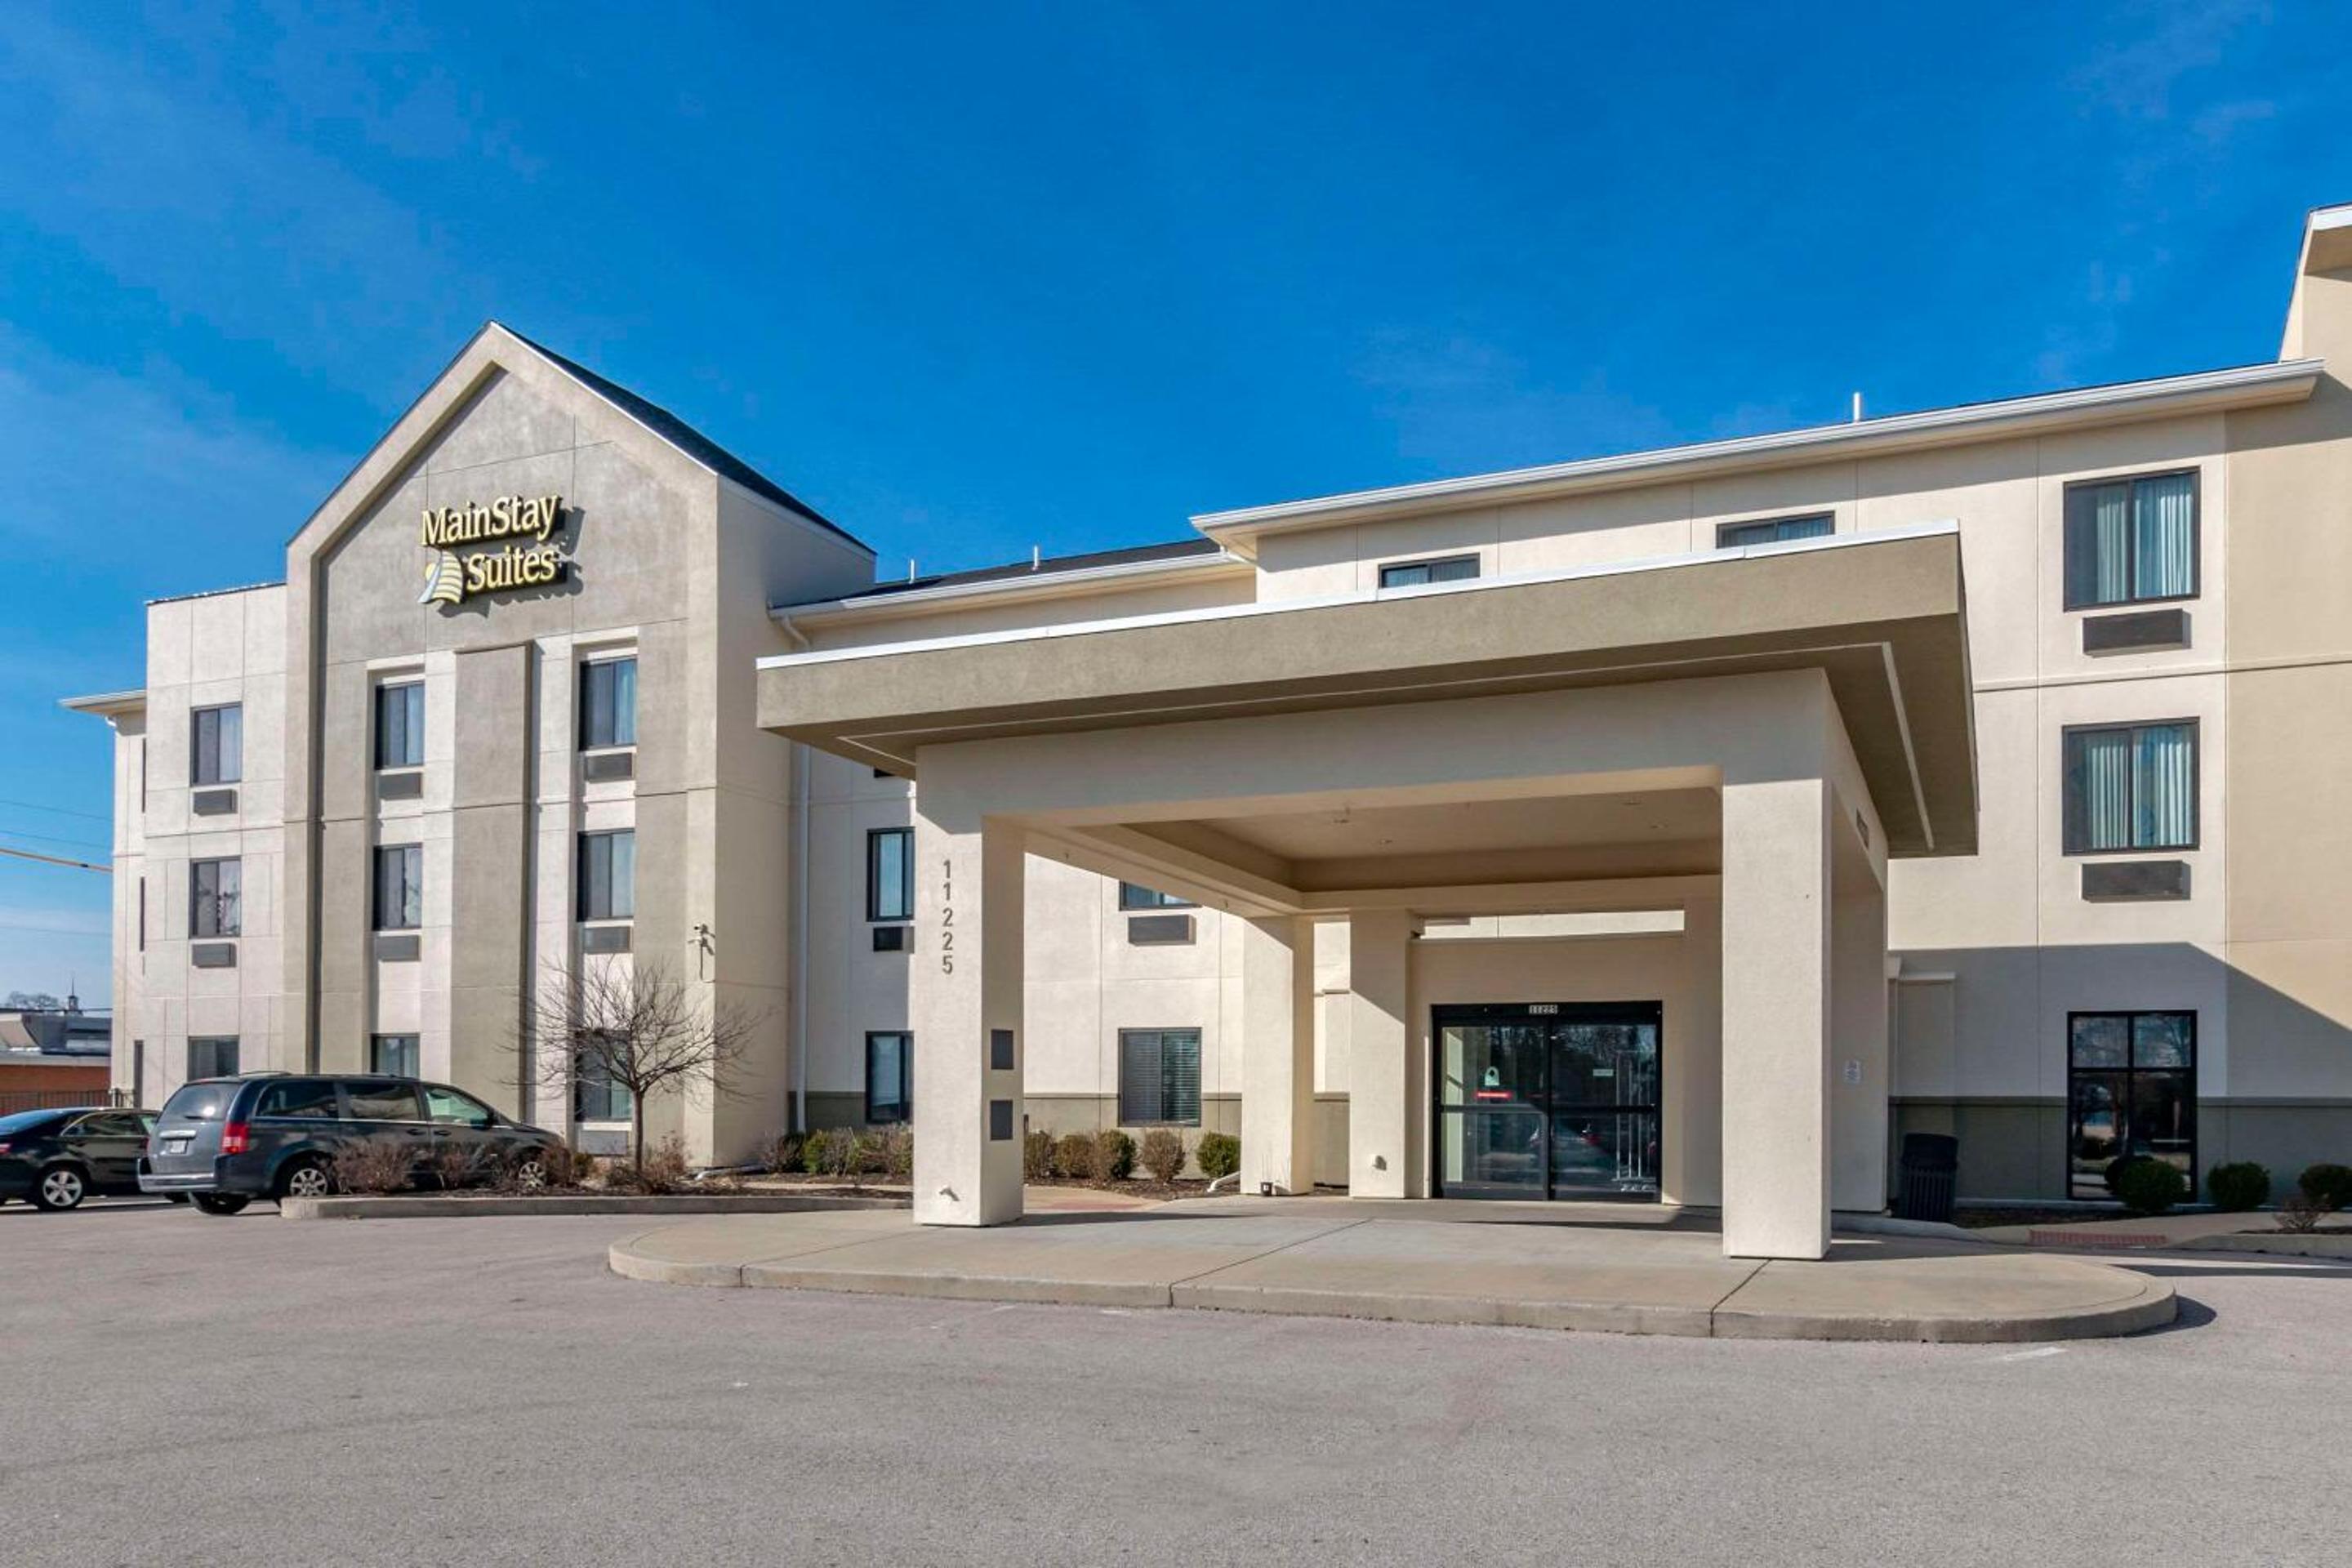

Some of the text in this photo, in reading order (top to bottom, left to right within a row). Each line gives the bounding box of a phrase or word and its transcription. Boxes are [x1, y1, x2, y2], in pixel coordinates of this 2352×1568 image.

[421, 495, 560, 546] MainStay
[466, 545, 558, 591] Suites
[942, 859, 954, 974] 11225
